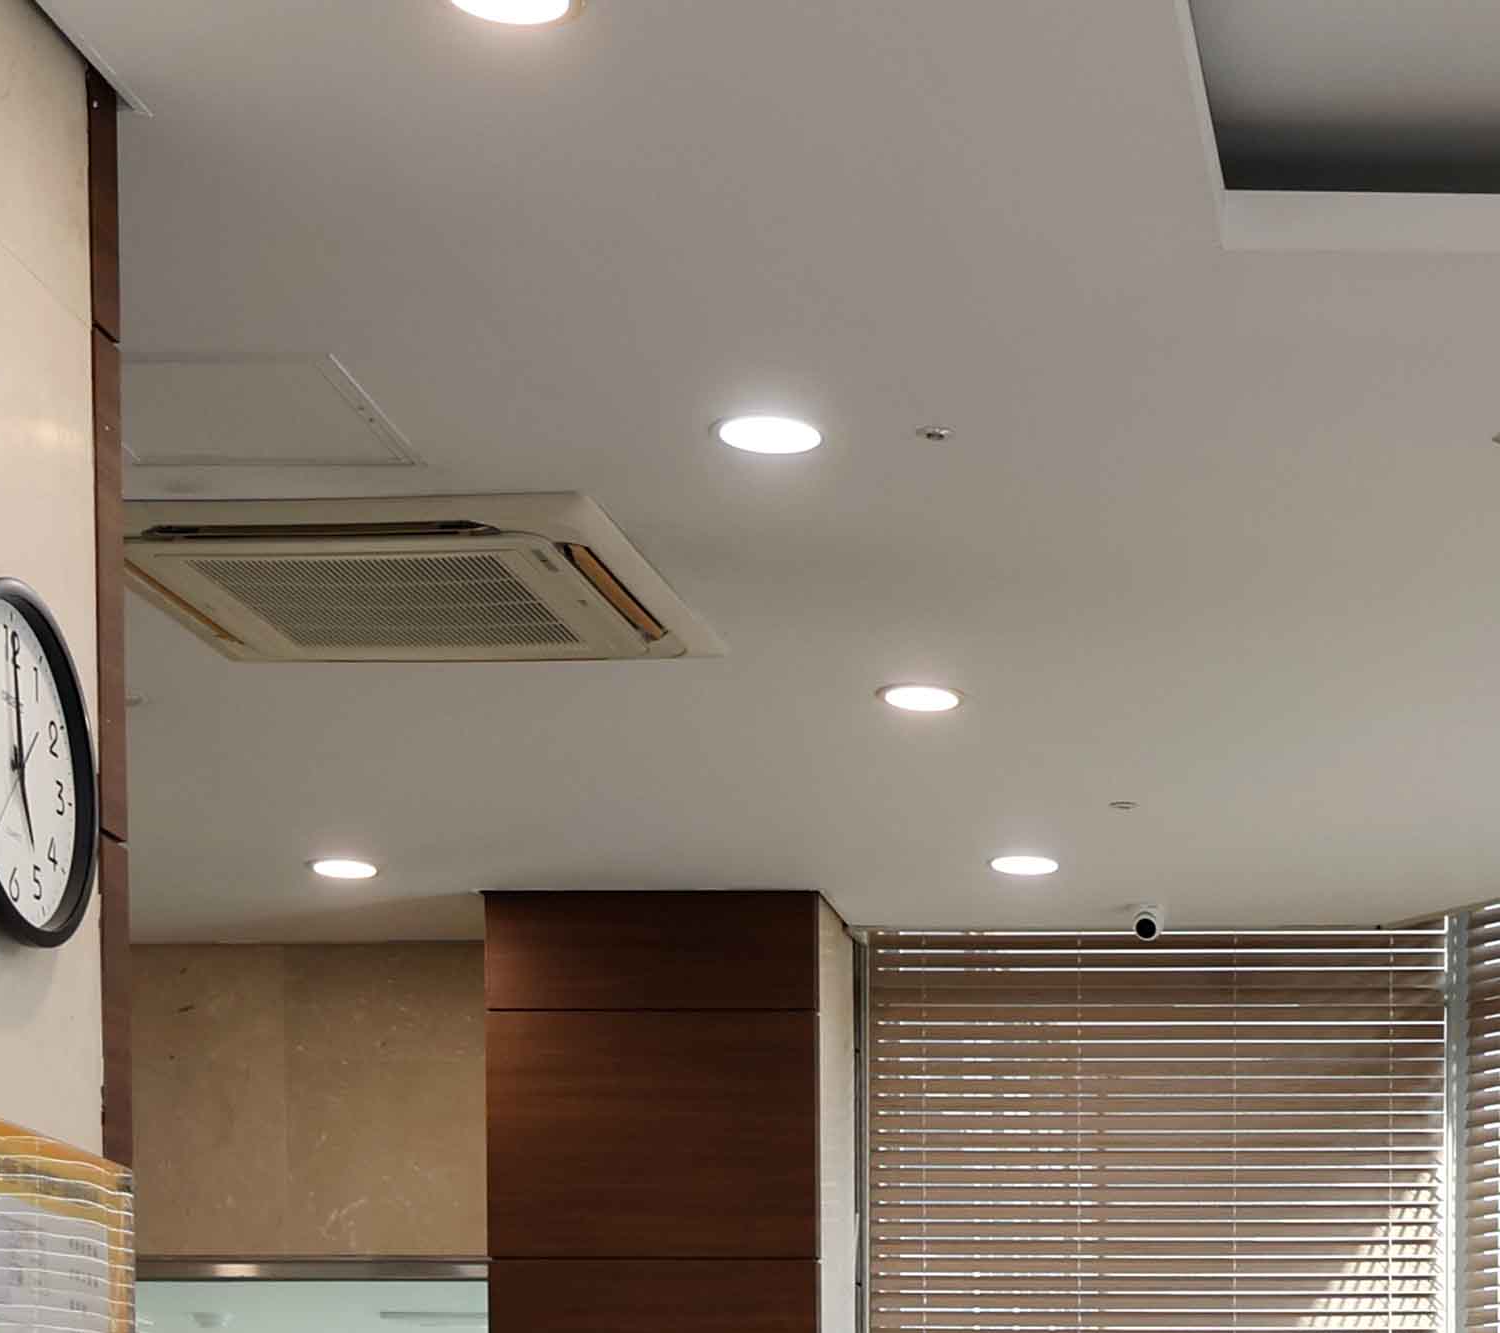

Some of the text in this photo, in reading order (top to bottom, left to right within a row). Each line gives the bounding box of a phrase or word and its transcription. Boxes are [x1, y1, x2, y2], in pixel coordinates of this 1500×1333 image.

[48, 720, 60, 758] 2
[55, 780, 65, 816] 3
[46, 837, 57, 872] 4
[9, 867, 20, 902] 6
[33, 865, 42, 901] 5
